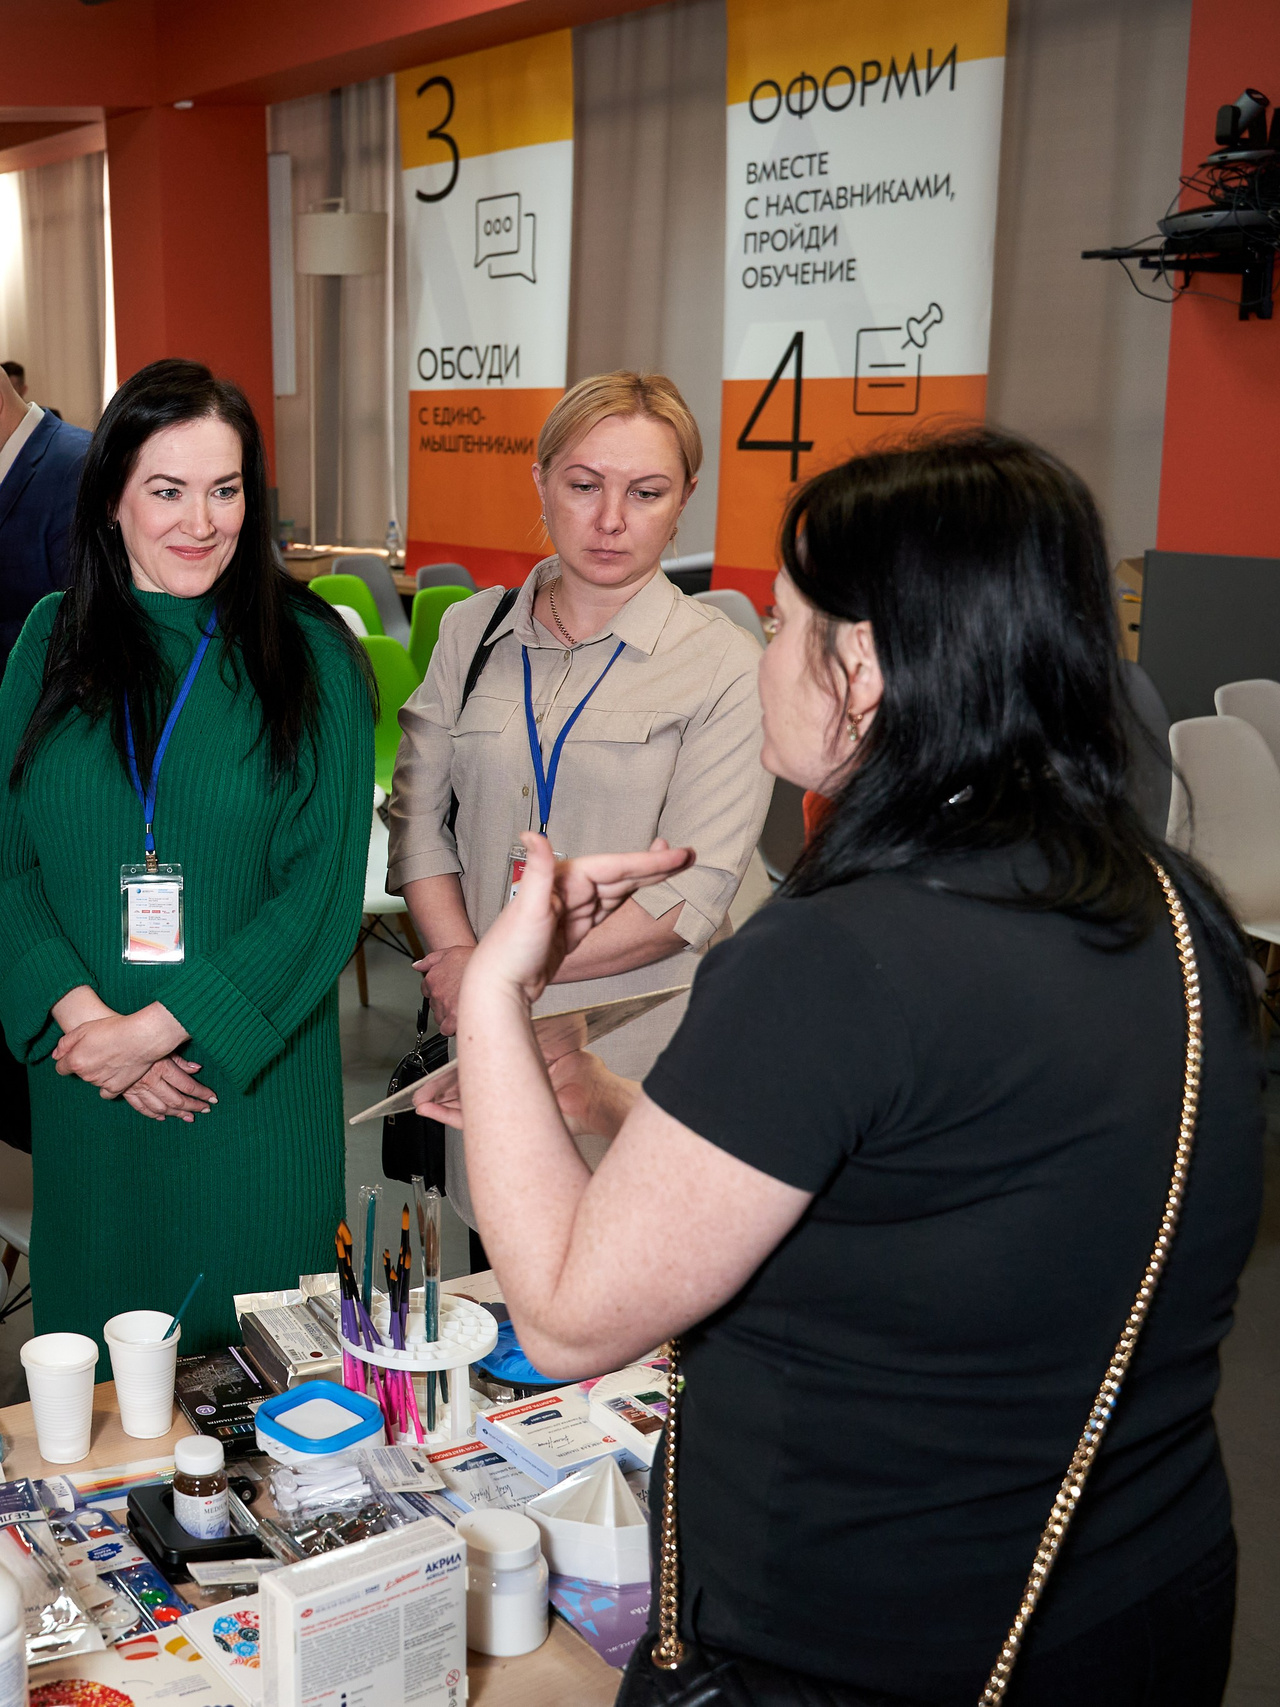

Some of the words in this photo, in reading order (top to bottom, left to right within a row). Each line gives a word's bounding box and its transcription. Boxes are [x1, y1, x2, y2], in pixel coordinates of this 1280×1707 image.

[748, 42, 958, 124] ОФОРМИ
[416, 76, 460, 203] 3
[745, 151, 830, 185] ВМЕСТЕ
[744, 196, 760, 220] С
[764, 172, 956, 218] НАСТАВНИКАМИ,
[742, 222, 838, 255] ПРОЙДИ
[741, 257, 858, 290] ОБУЧЕНИЕ
[416, 344, 520, 386] ОБСУДИ
[418, 407, 429, 426] С
[432, 405, 487, 428] ЕДИНО-
[736, 331, 815, 481] 4
[199, 1406, 213, 1415] 12
[429, 1448, 466, 1462] WATERCOLO
[466, 1444, 479, 1452] FOR
[425, 1553, 462, 1574] АКРИЛ
